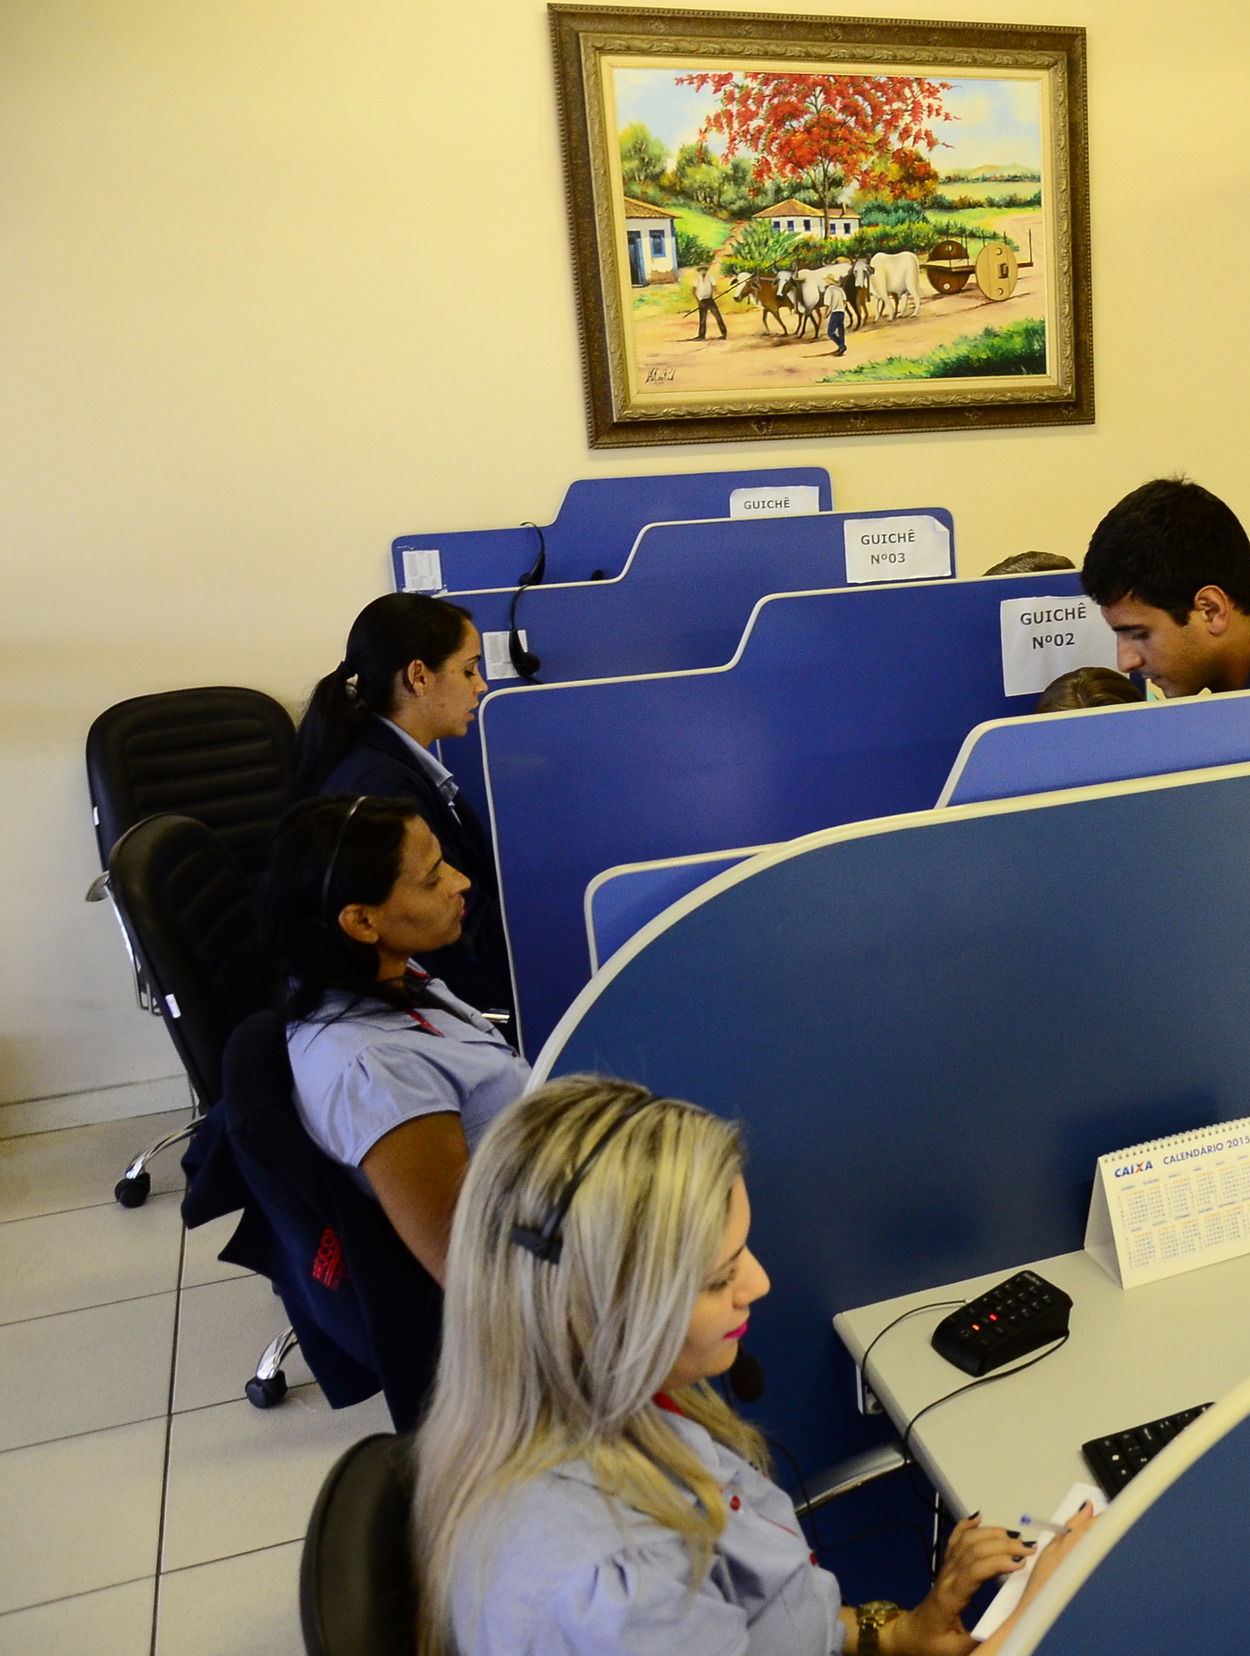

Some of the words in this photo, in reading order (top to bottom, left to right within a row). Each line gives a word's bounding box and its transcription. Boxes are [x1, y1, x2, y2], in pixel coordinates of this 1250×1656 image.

[744, 497, 790, 509] GUICHÊ
[861, 529, 915, 545] GUICHÊ
[871, 553, 905, 564] Nº03
[1021, 602, 1086, 625] GUICHÊ
[1032, 633, 1075, 649] Nº02
[1115, 1160, 1153, 1178] CAIXA
[1163, 1142, 1223, 1165] CALENDÁRIO
[1227, 1136, 1250, 1149] 2015
